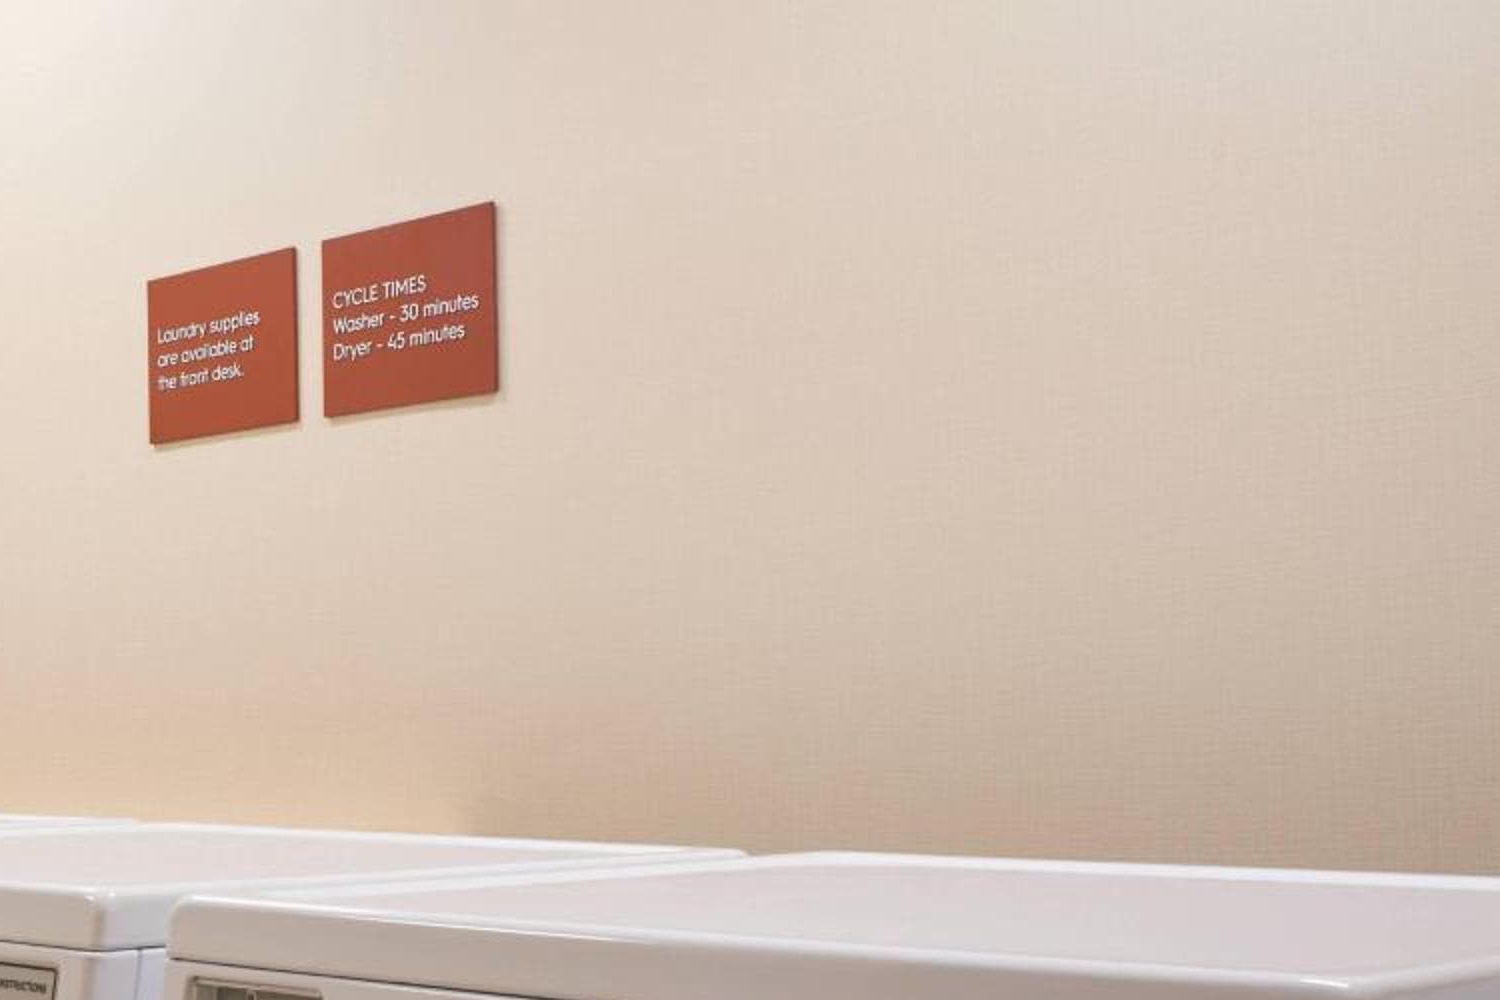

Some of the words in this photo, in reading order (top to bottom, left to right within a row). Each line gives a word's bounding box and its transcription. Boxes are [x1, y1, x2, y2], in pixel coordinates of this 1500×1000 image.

[332, 284, 379, 309] CYCLE
[382, 275, 427, 299] TIMES
[157, 322, 207, 345] Laundry
[209, 311, 261, 334] supplies
[333, 312, 385, 335] Washer
[399, 303, 419, 322] 30
[423, 293, 480, 317] minutes
[157, 352, 179, 368] are
[181, 339, 237, 363] available
[240, 334, 255, 352] at
[333, 341, 373, 361] Dryer
[387, 331, 405, 350] 45
[409, 324, 466, 346] minutes
[157, 374, 178, 391] the
[180, 368, 209, 387] front
